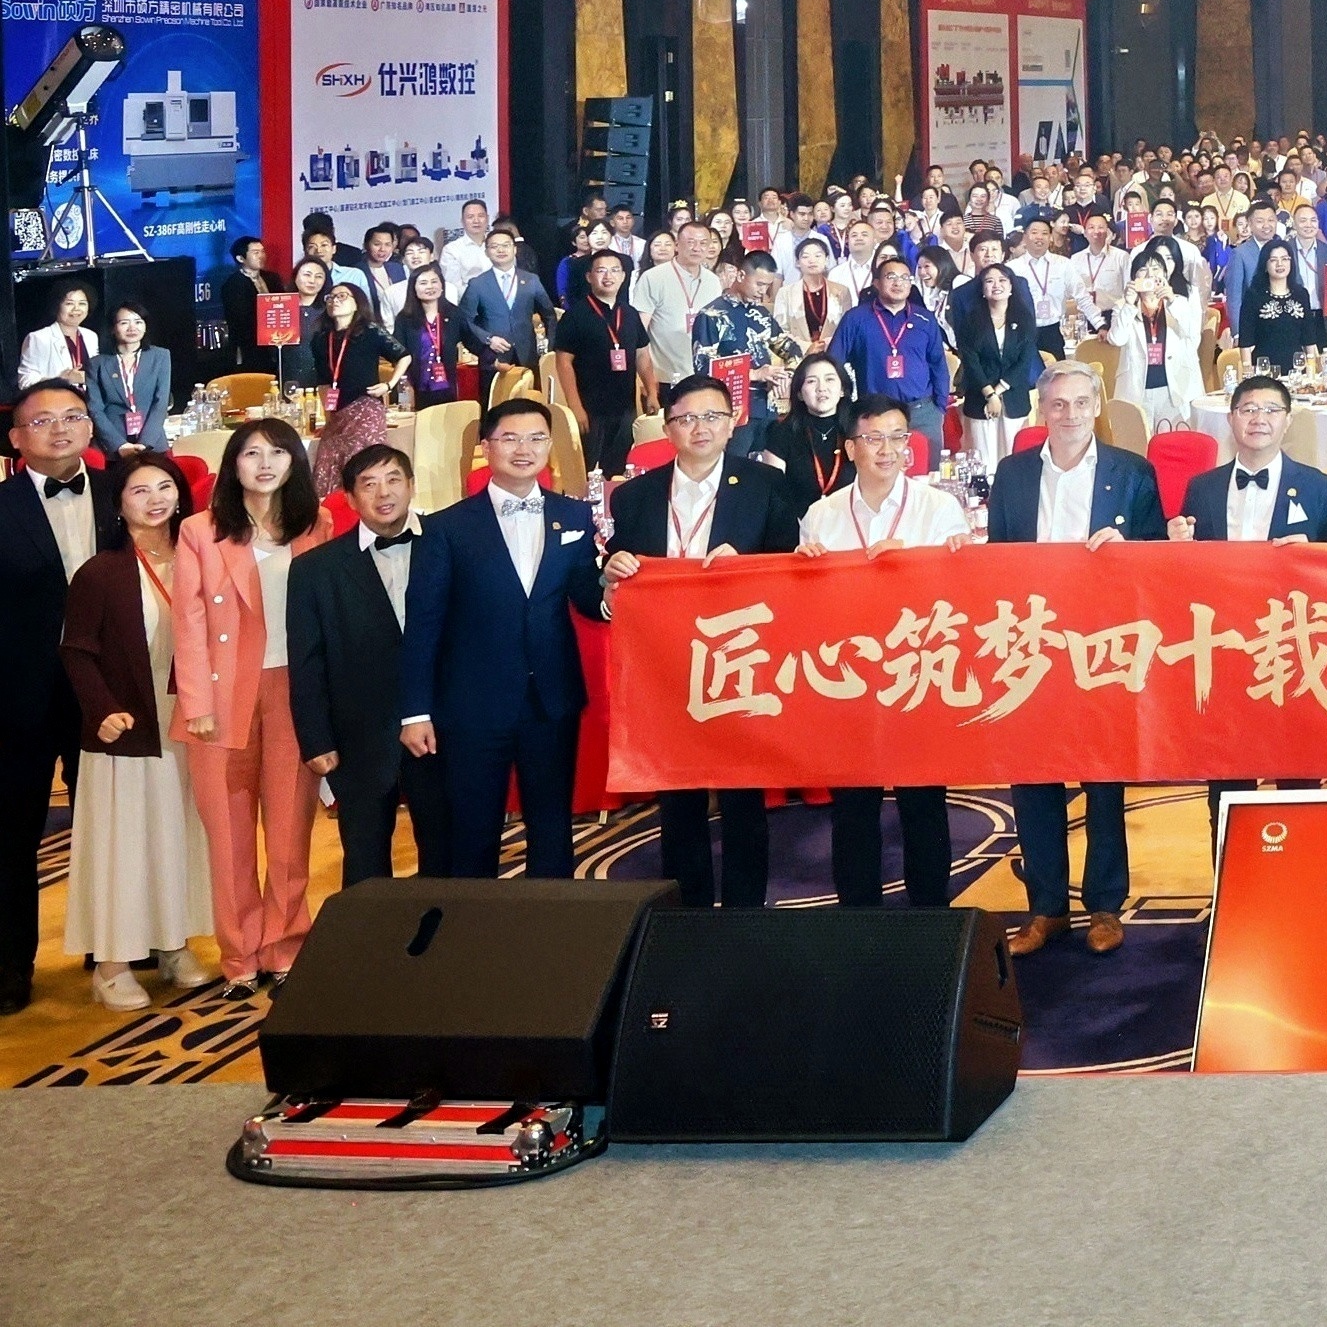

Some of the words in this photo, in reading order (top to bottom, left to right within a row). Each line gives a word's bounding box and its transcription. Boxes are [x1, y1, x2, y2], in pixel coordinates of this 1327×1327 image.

[378, 62, 476, 96] 仕兴鸿数控
[1261, 844, 1284, 852] SZMA
